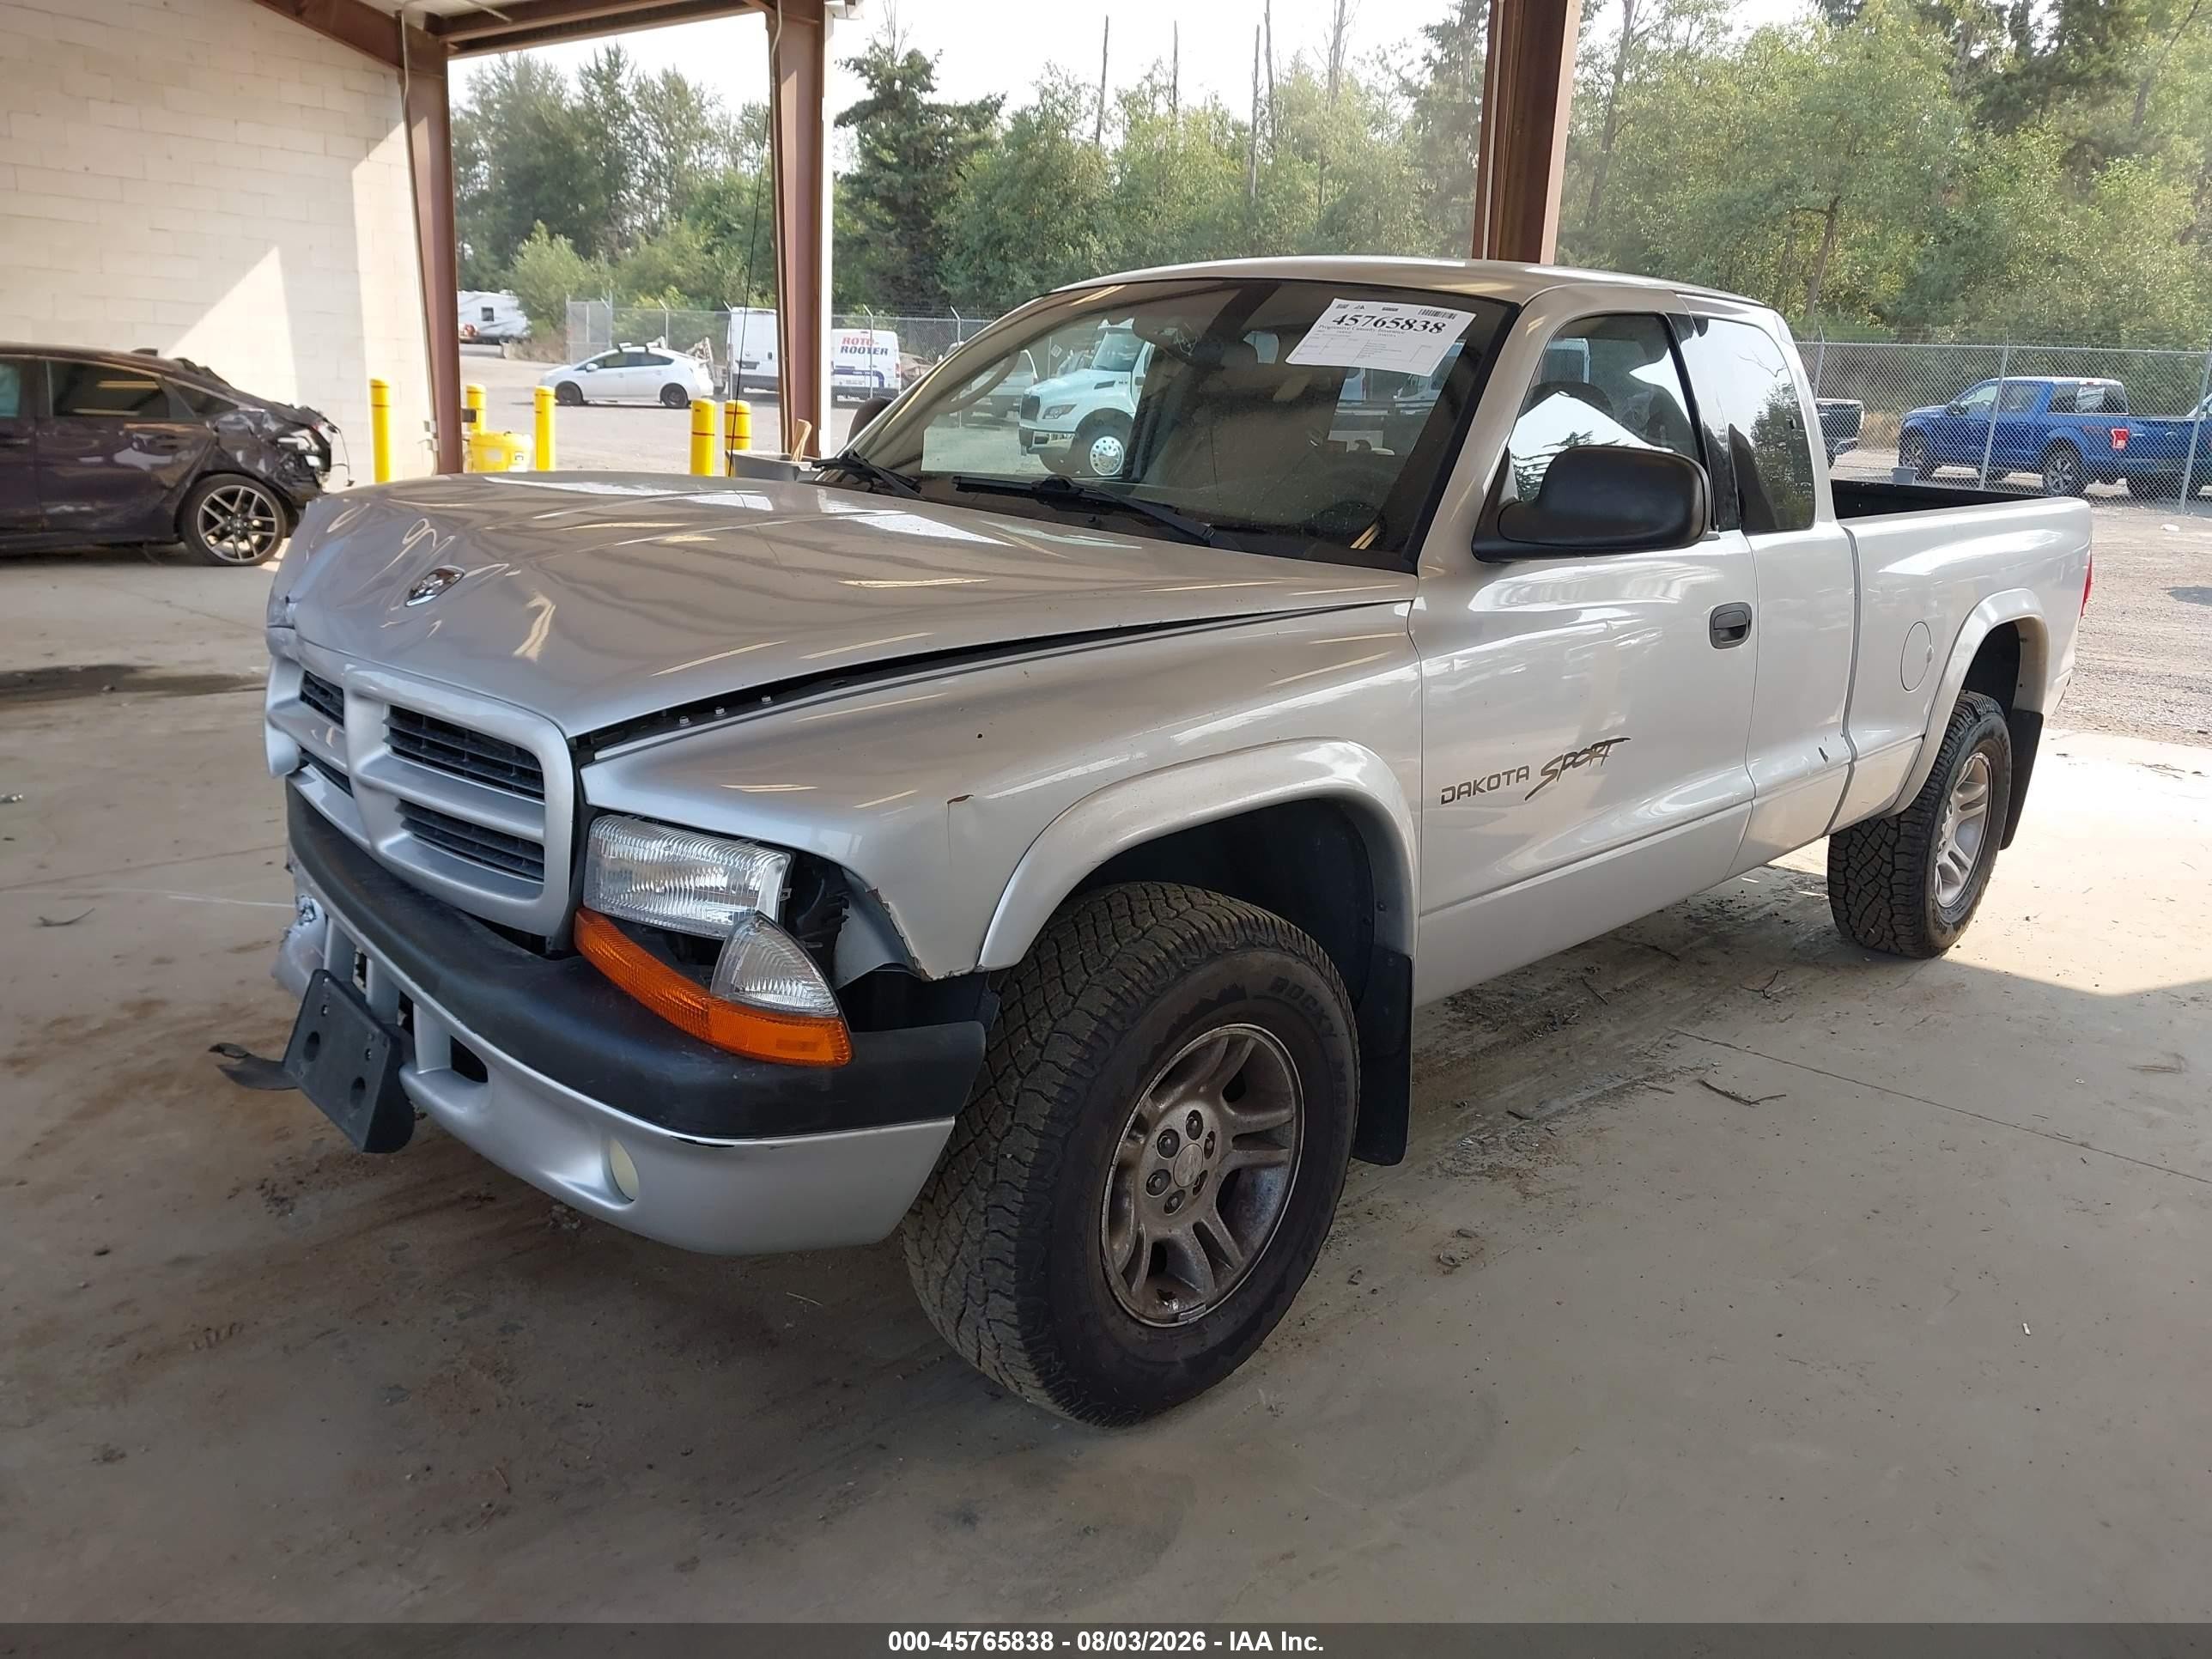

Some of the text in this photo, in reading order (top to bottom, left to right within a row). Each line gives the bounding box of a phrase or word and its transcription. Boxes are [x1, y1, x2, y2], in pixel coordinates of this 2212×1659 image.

[1332, 313, 1446, 334] 45765838
[840, 345, 889, 356] ROOTER
[1441, 737, 1632, 805] DAKOTA SPORT
[1270, 975, 1338, 1039] ROCKY
